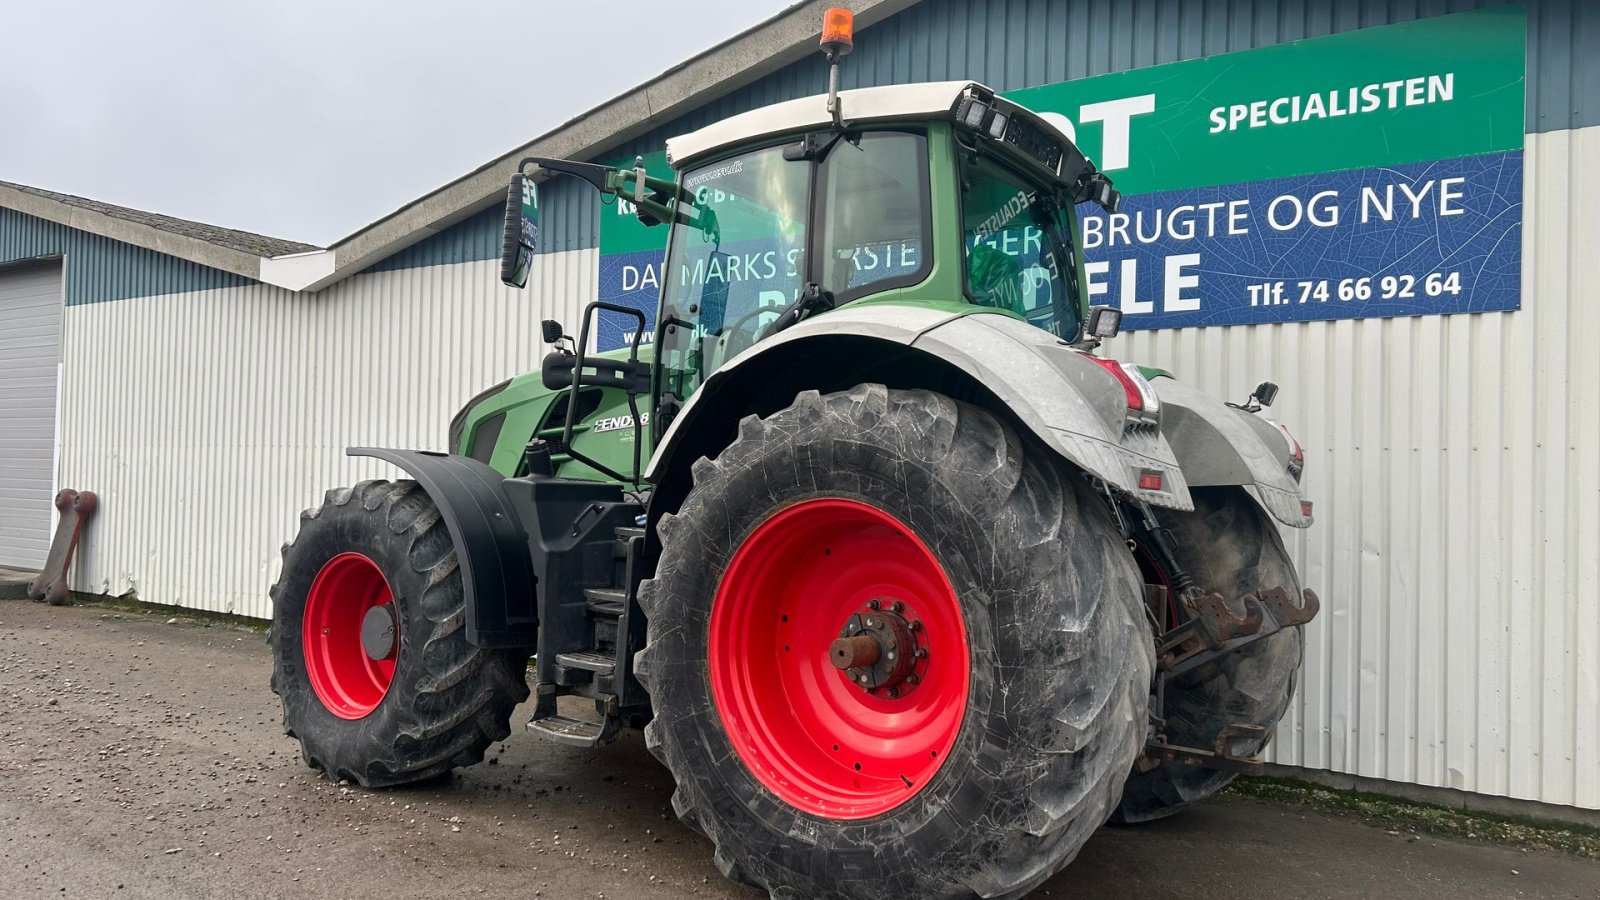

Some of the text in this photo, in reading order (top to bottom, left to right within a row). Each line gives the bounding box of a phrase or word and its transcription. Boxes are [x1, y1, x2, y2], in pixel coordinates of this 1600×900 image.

[1210, 73, 1454, 134] SPECIALISTEN
[1083, 199, 1249, 249] BRUGTE
[1267, 190, 1339, 231] OG
[1361, 177, 1465, 223] NYE
[1247, 272, 1462, 307] Tlf. 74 66 92 64
